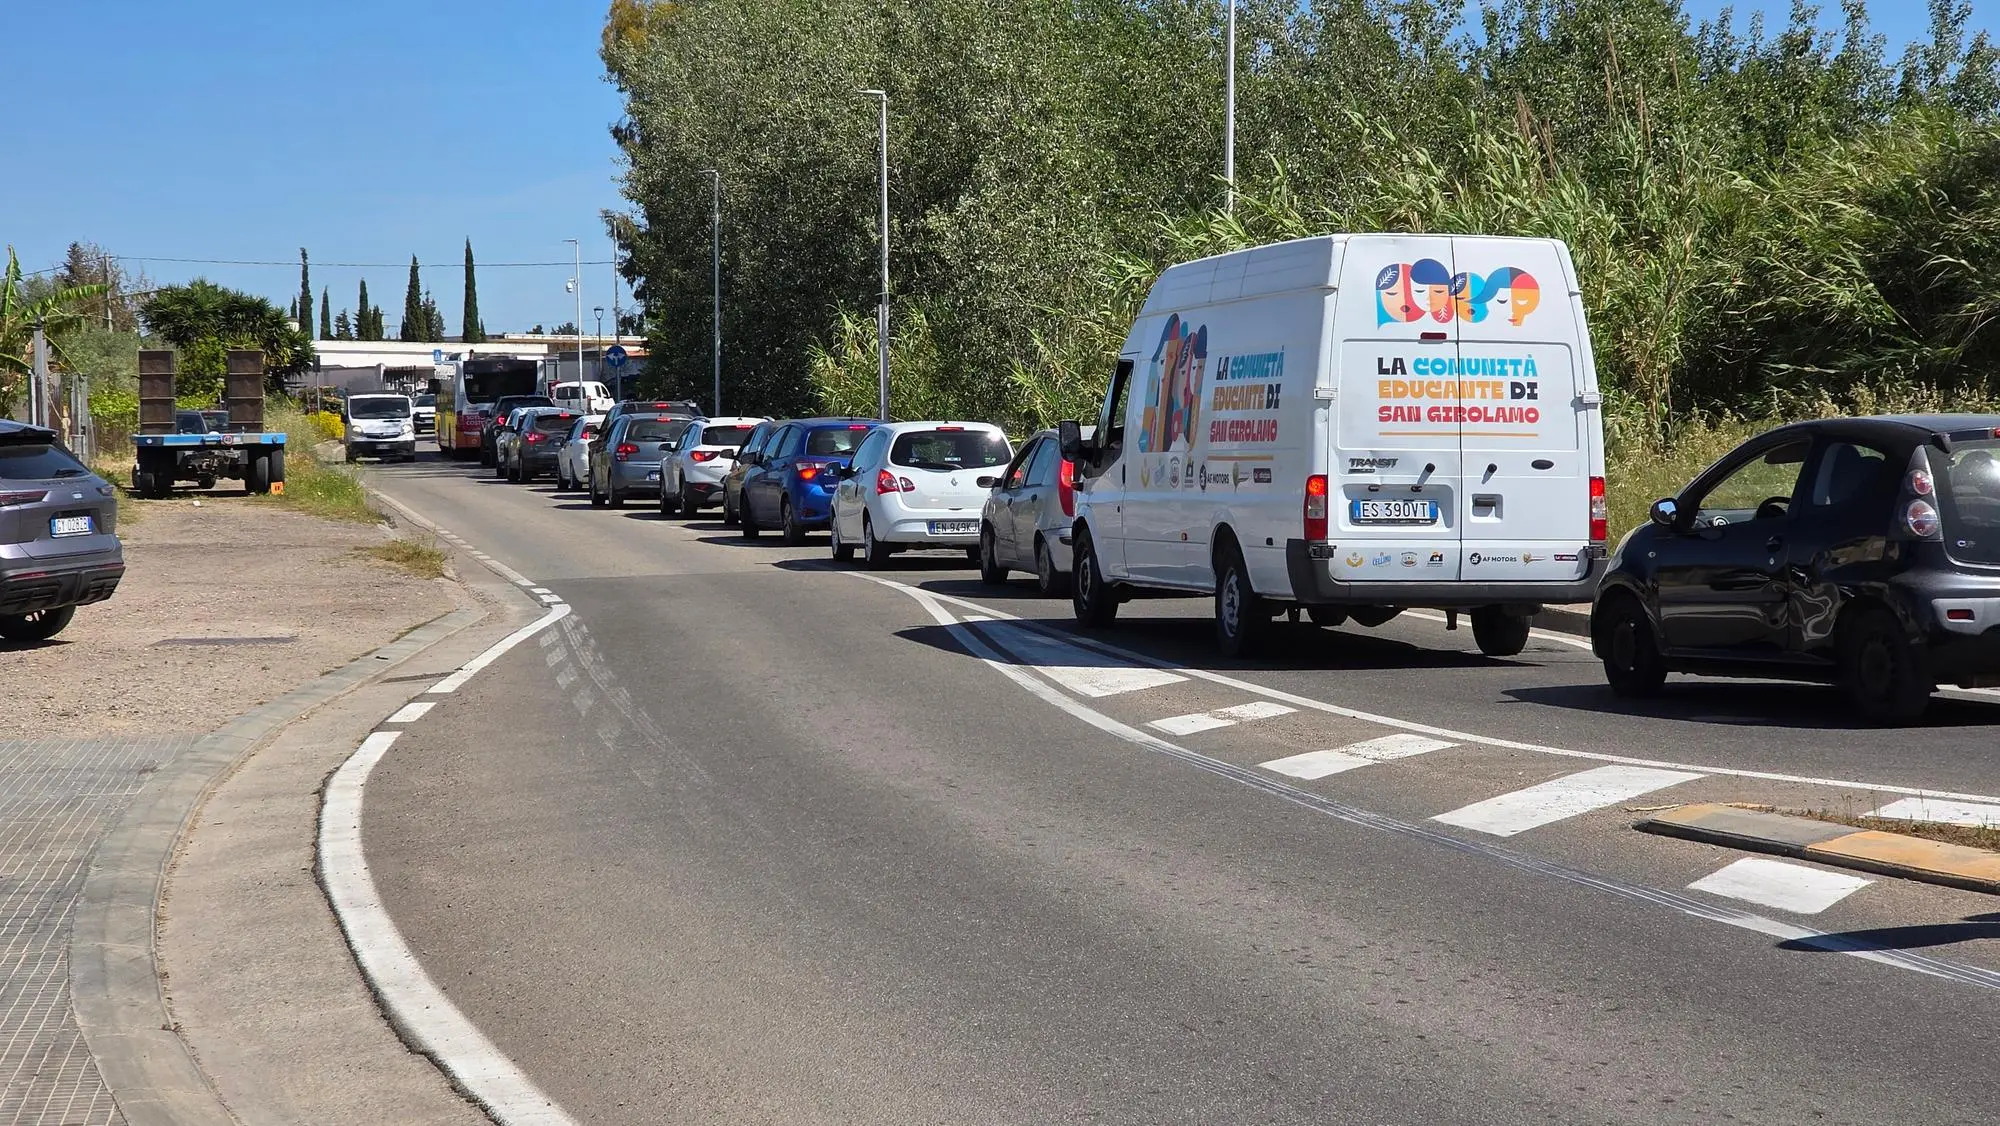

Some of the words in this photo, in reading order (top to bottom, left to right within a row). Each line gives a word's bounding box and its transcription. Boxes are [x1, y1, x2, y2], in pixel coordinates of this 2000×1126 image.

[1216, 356, 1229, 380] LA
[1230, 345, 1285, 379] COMUNITÀ
[1377, 357, 1407, 375] LA
[1412, 354, 1538, 377] COMUNITÀ
[1212, 384, 1265, 411] EDUCANTE
[1265, 383, 1281, 409] DI
[1378, 380, 1504, 400] EDUCANTE
[1510, 381, 1538, 400] DI
[1378, 406, 1422, 423] SAN
[1427, 406, 1540, 424] GIROLAMO
[1210, 420, 1228, 443] SAN
[1228, 419, 1278, 442] GIROLAMO
[1348, 457, 1399, 469] TRANSIT
[1213, 473, 1230, 484] MOTORS
[1362, 503, 1379, 517] ES
[1384, 503, 1428, 517] 390VT
[936, 522, 947, 532] EN
